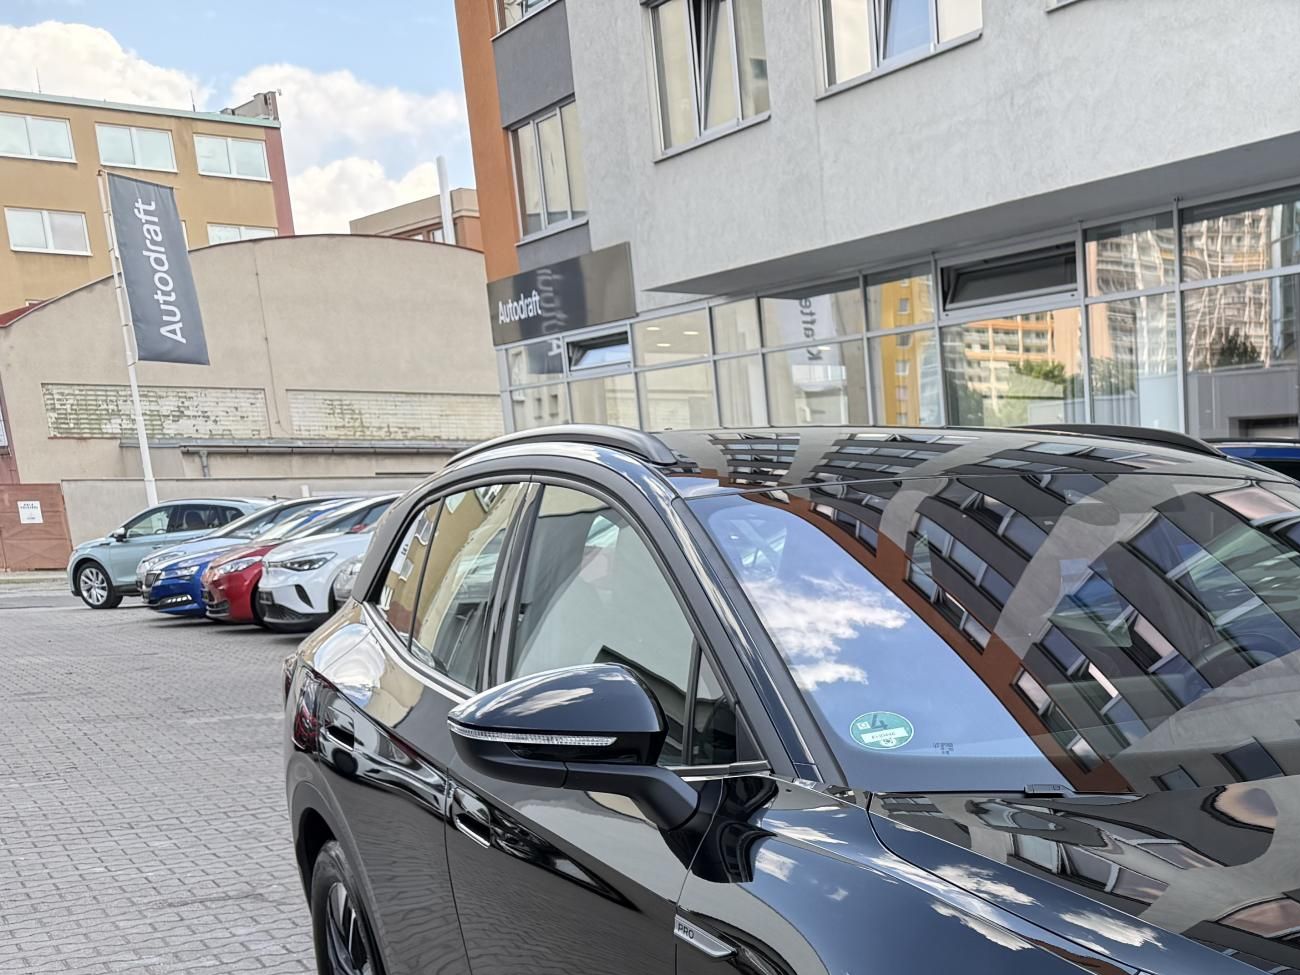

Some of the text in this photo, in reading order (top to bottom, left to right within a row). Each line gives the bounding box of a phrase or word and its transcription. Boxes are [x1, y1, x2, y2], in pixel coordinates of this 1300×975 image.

[133, 198, 187, 344] Autodraft
[498, 289, 542, 325] Autodraft
[678, 923, 694, 939] PRO
